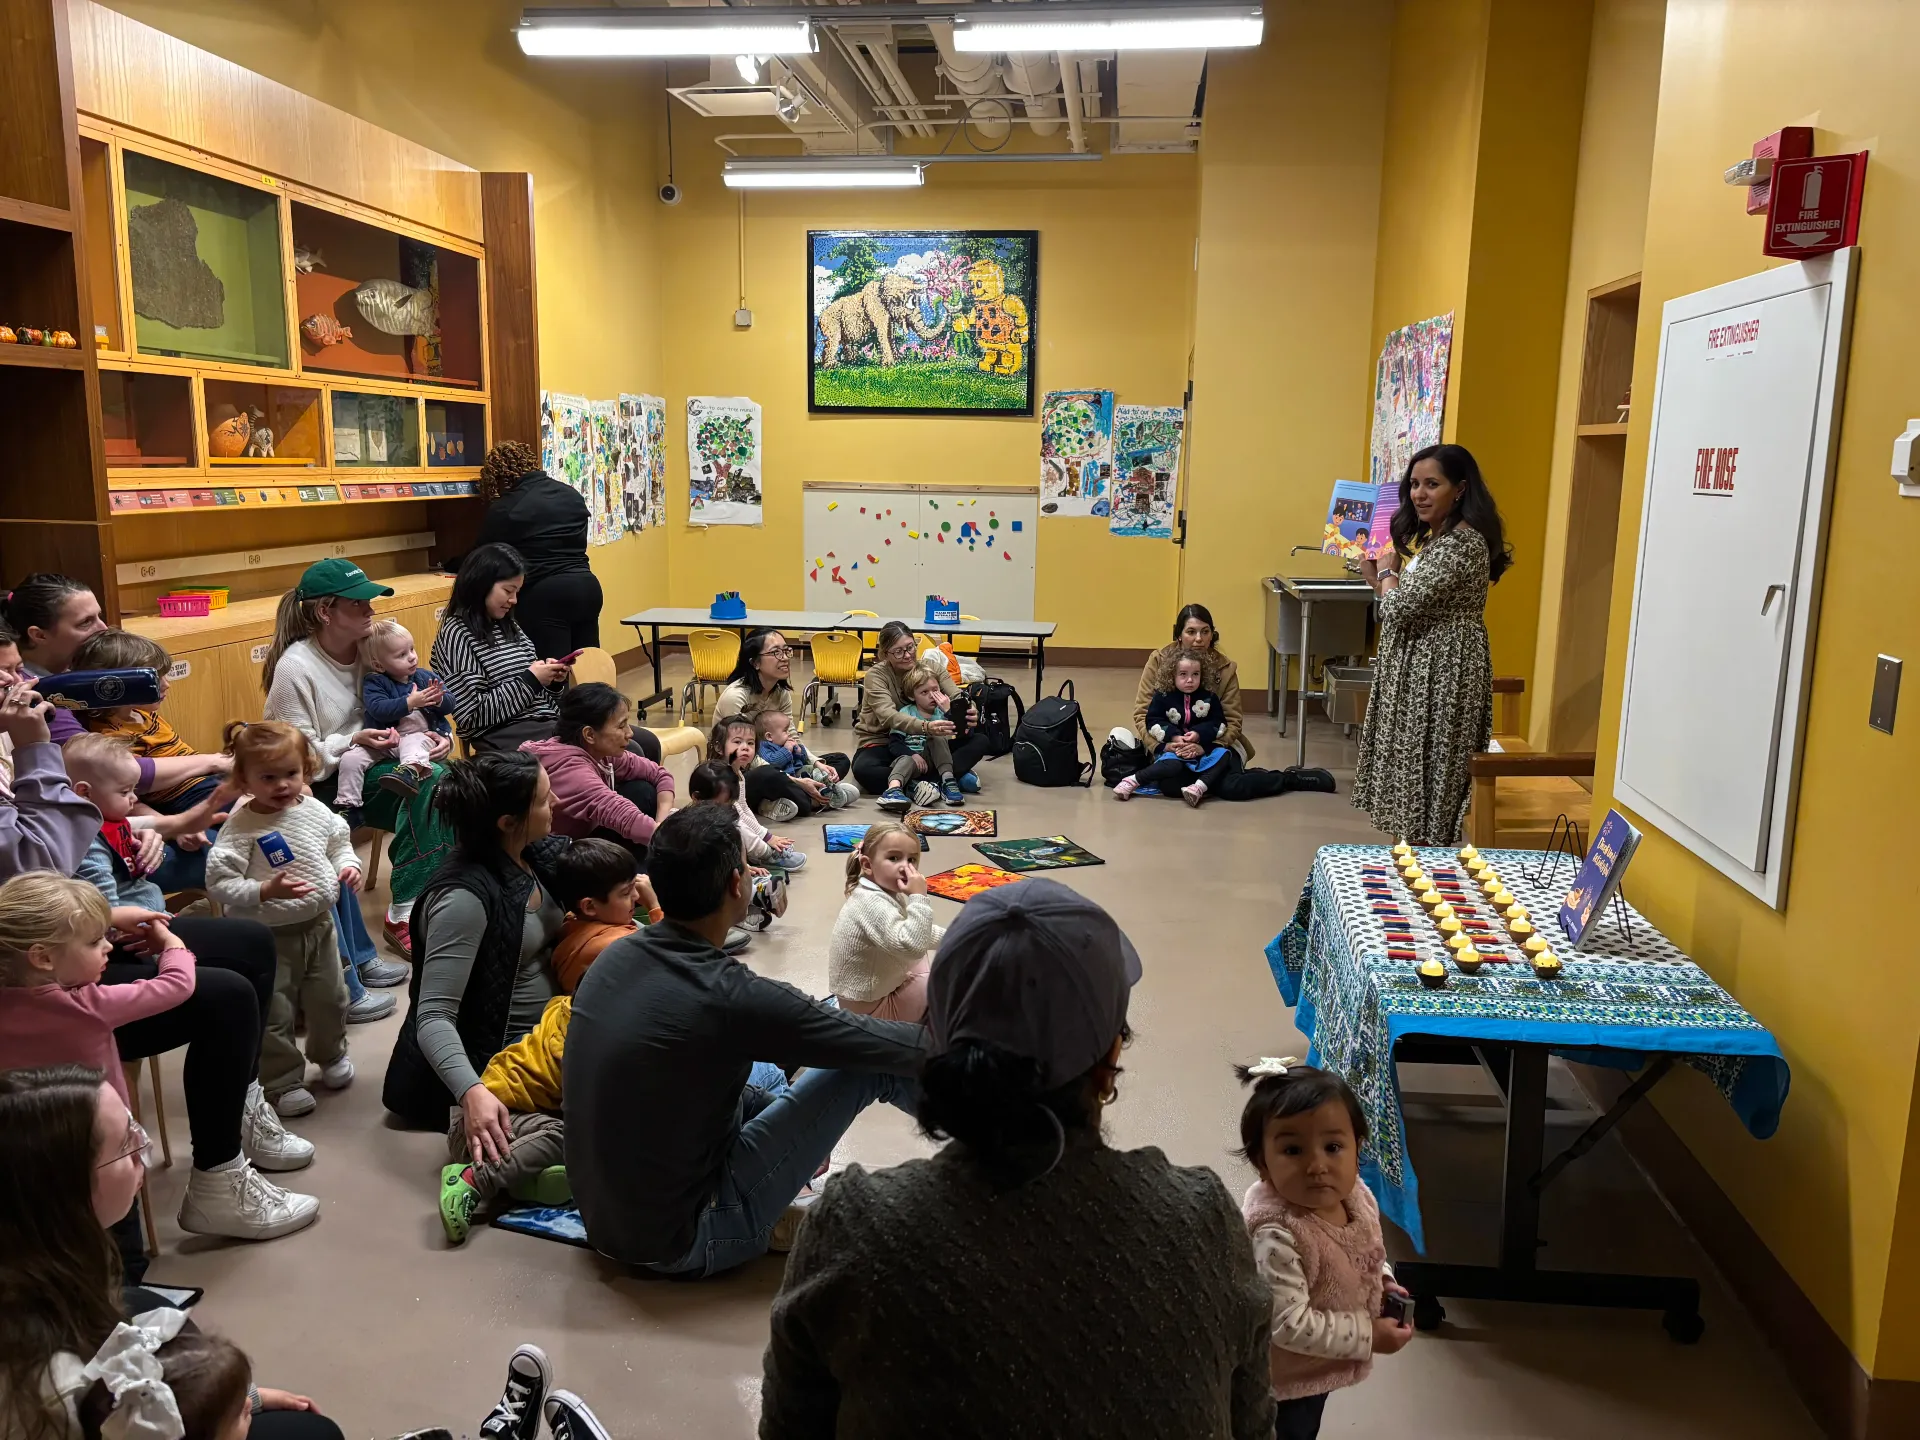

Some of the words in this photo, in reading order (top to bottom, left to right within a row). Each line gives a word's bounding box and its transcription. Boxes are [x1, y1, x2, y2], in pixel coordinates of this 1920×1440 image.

[1798, 210, 1819, 220] FIRE
[1775, 220, 1840, 233] EXTINGUISHER
[1708, 328, 1720, 349] FIRE
[1719, 319, 1759, 347] EXTINGUISHER
[1694, 448, 1715, 489] FIRE
[1713, 448, 1739, 490] HOSE
